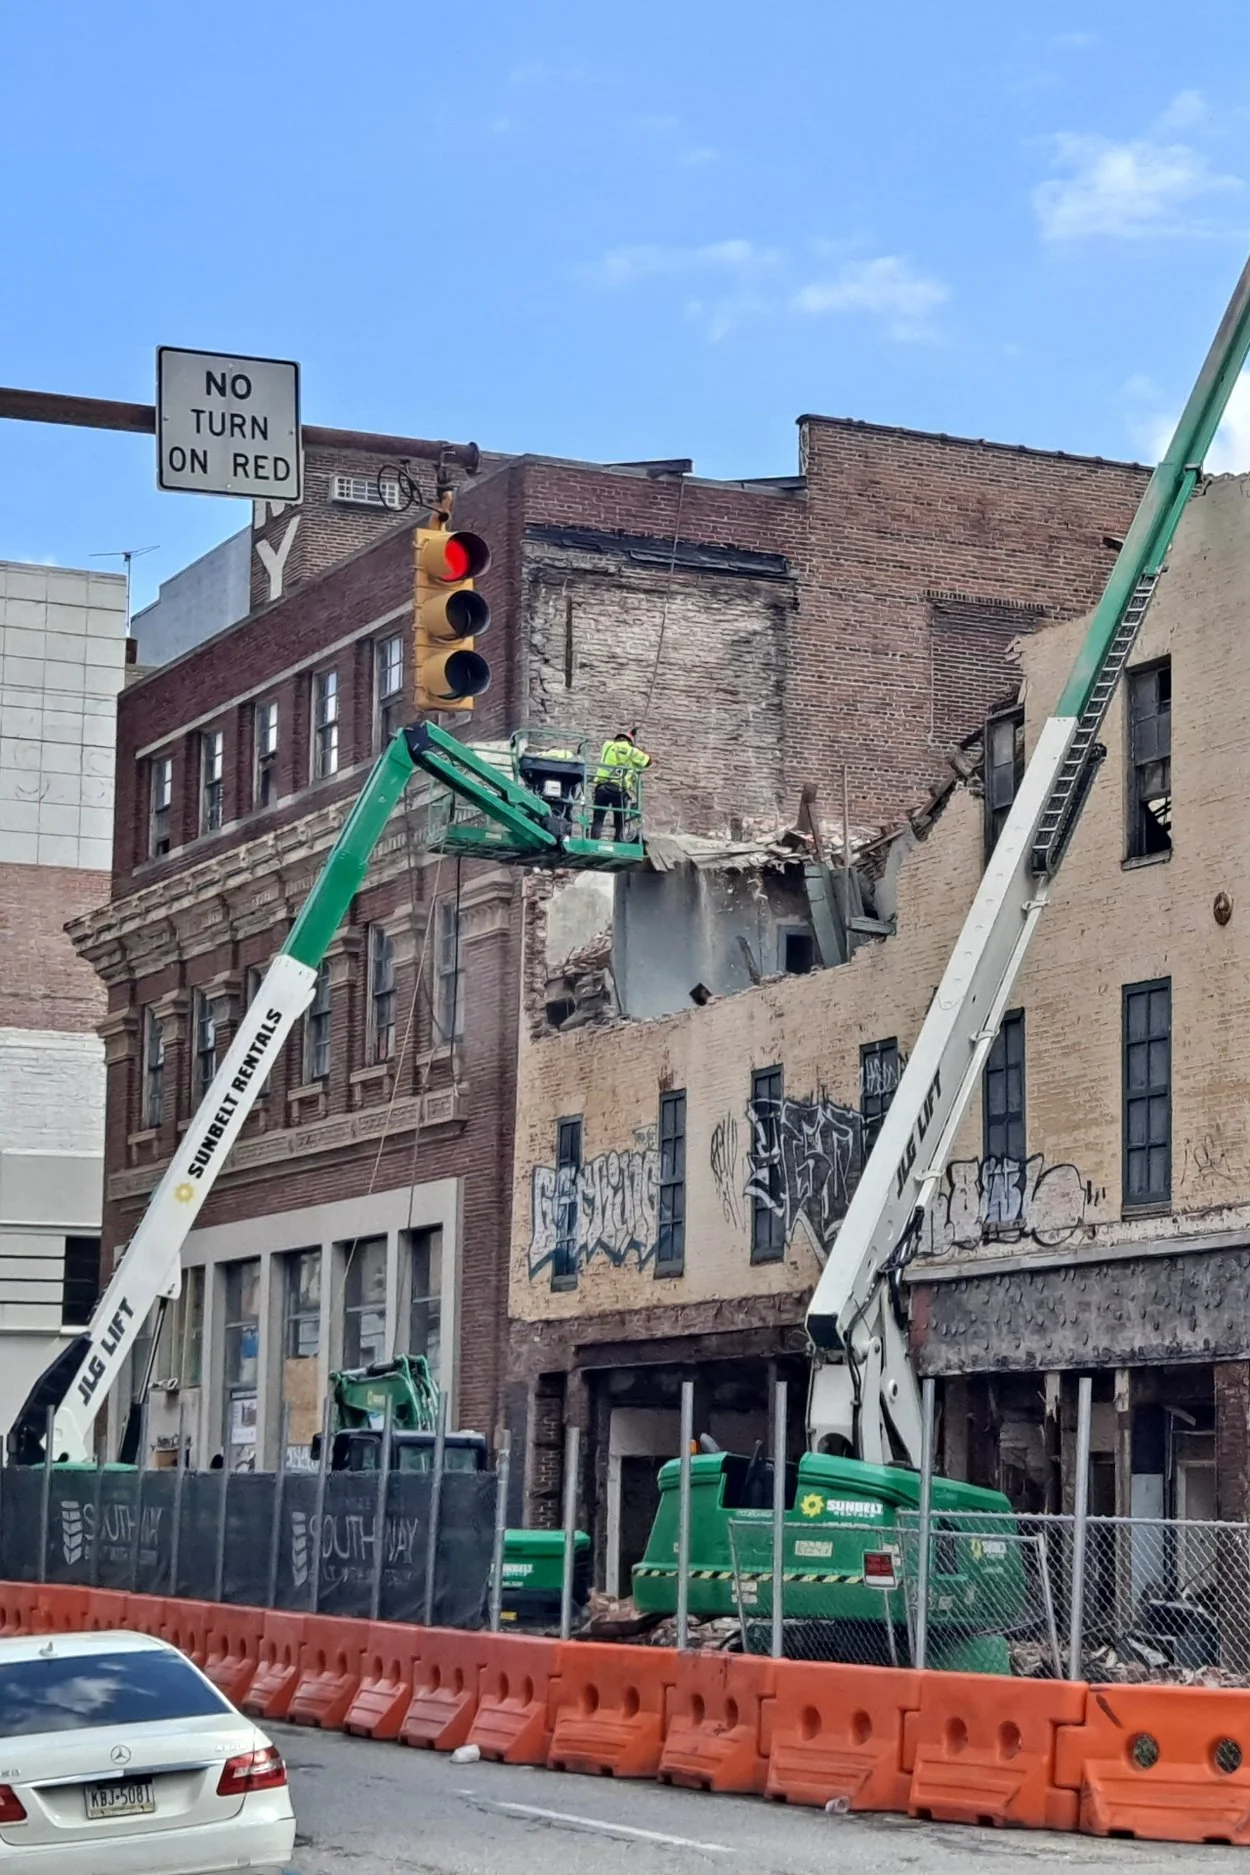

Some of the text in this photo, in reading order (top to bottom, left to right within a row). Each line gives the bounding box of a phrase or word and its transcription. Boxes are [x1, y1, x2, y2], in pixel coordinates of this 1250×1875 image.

[205, 370, 252, 400] NO
[190, 409, 268, 441] TURN
[168, 446, 290, 481] ON RED
[187, 1008, 283, 1179] SUNBELT RENTALS
[896, 1068, 942, 1201] JLG LIFT
[77, 1297, 134, 1407] JLG LIFT
[826, 1499, 884, 1515] SUNBELT
